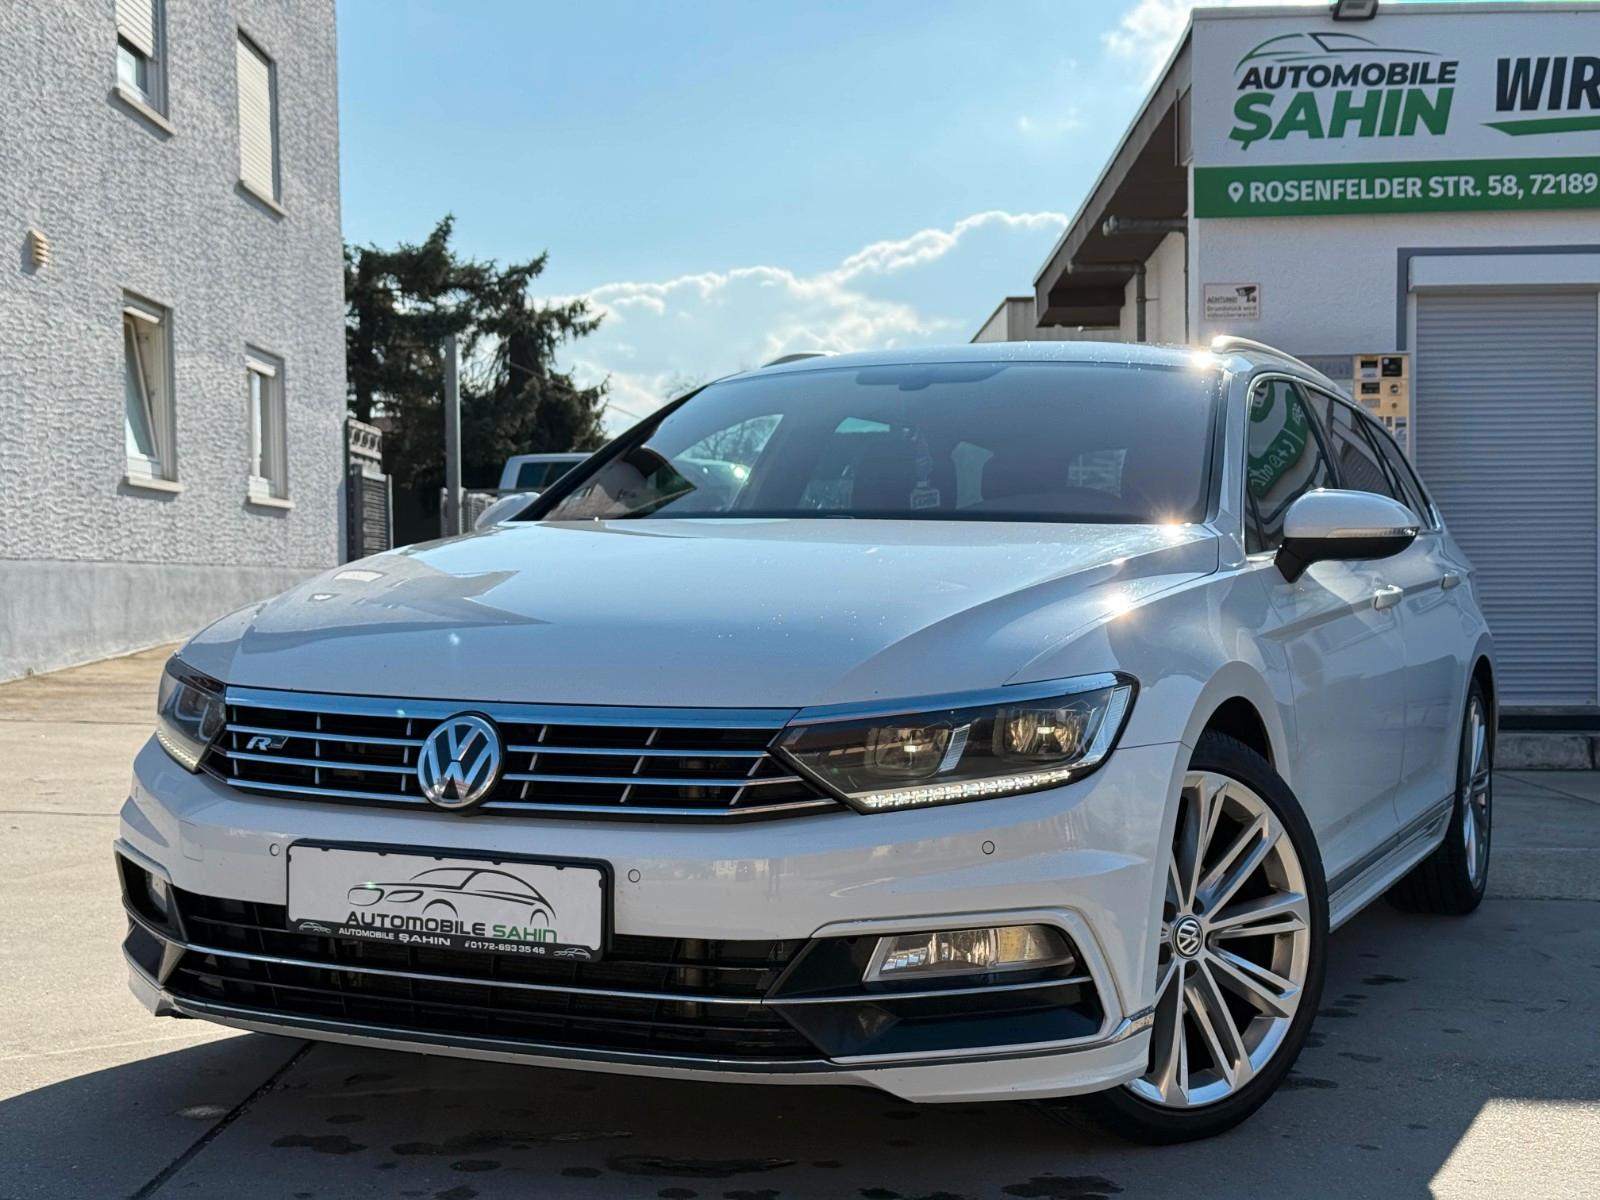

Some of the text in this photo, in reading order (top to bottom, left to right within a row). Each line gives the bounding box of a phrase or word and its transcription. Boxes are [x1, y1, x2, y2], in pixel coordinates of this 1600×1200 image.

[1237, 61, 1459, 90] AUTOMOBILE
[1496, 56, 1600, 112] WIR
[1228, 87, 1454, 151] ŞAHIN
[1250, 172, 1598, 202] ROSENFELDER STR. 58, 72189
[338, 927, 395, 940] AUTOMOBILE
[345, 911, 557, 943] AUTOMOBILE SAHIN
